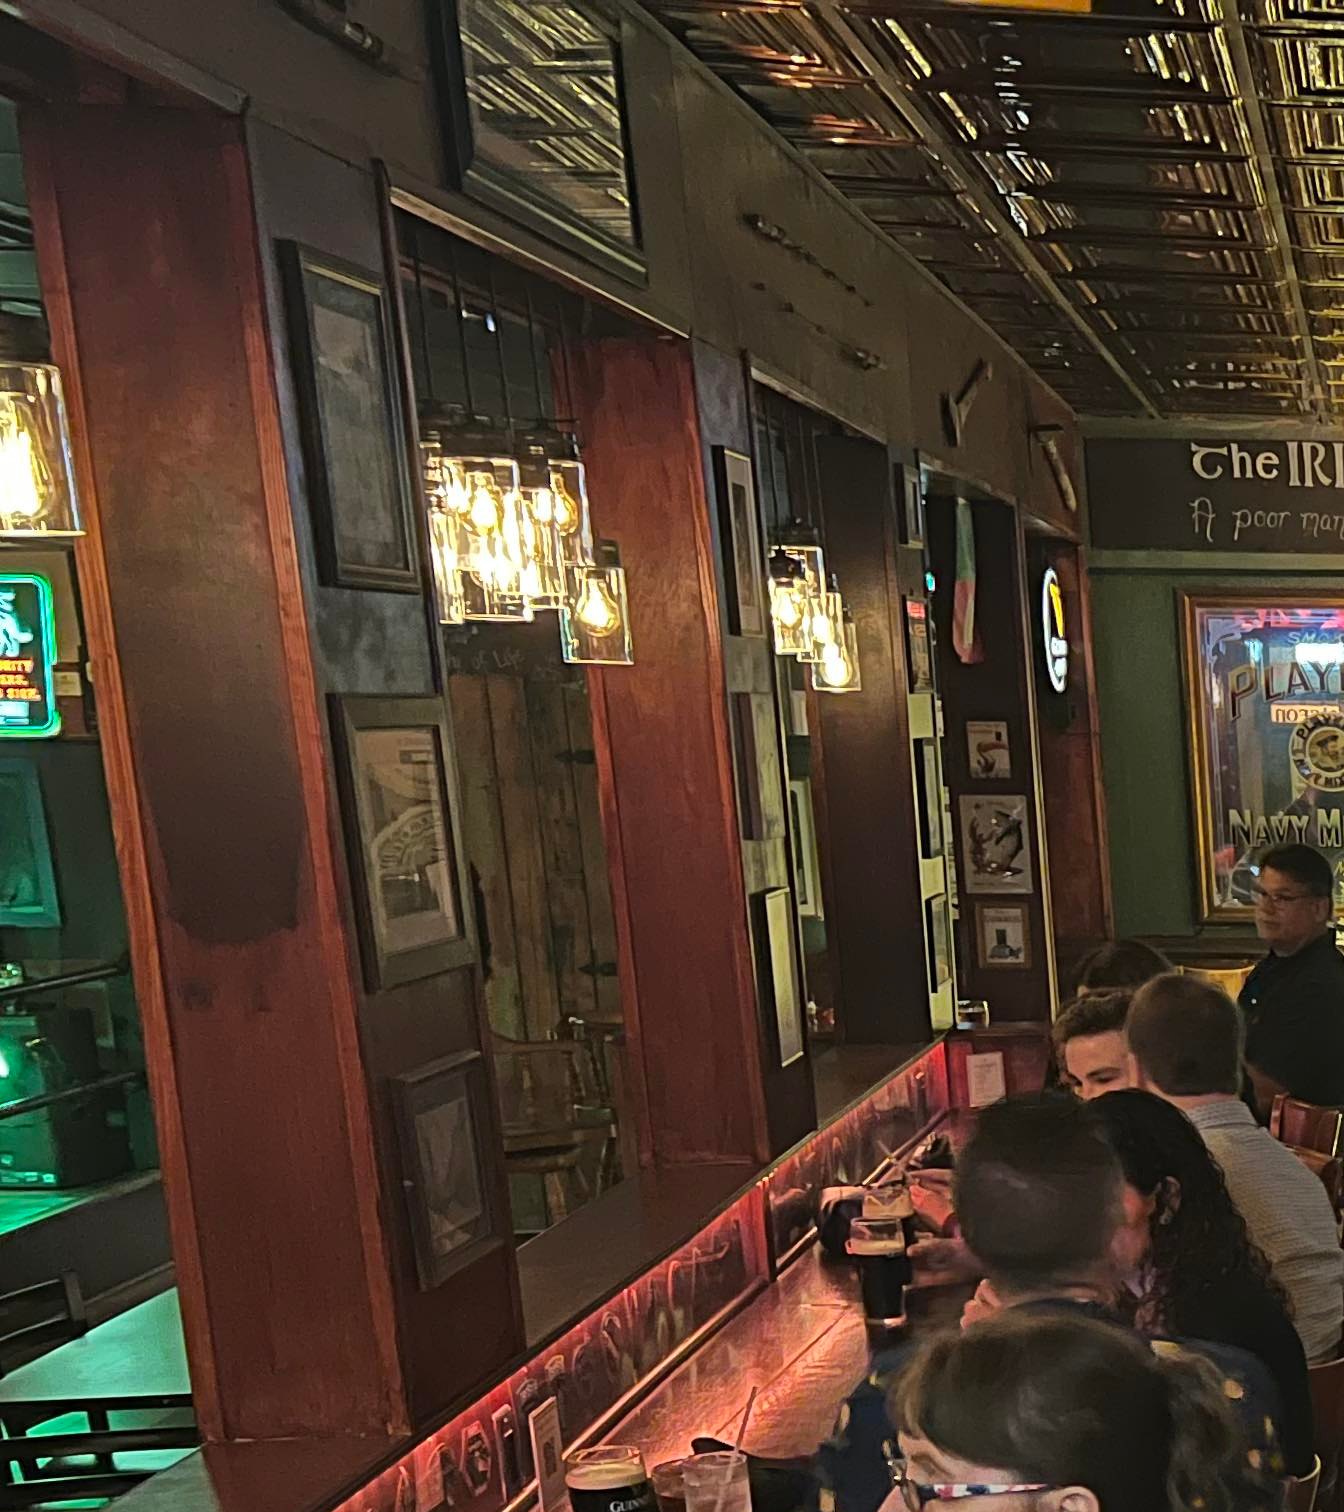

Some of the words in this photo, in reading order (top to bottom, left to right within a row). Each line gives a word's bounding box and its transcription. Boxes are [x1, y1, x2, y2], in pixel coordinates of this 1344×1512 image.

[1190, 441, 1280, 480] The
[1189, 497, 1215, 543] A
[1232, 508, 1292, 541] poor
[1228, 808, 1309, 848] NAVY
